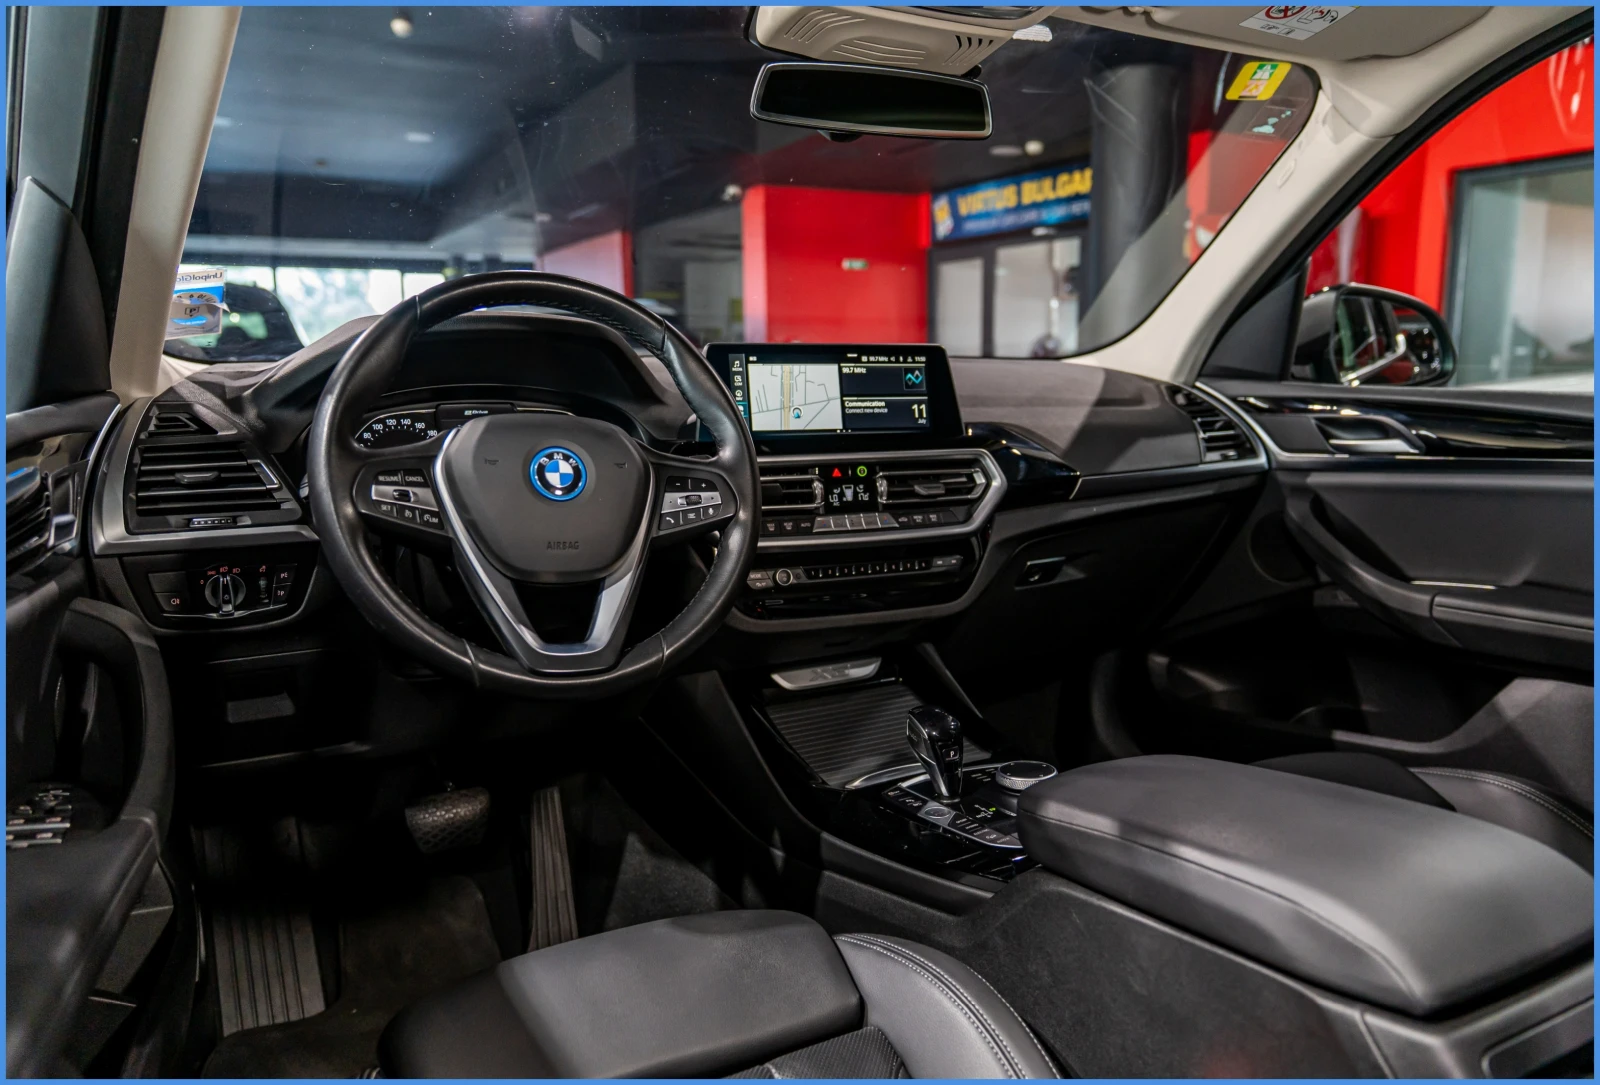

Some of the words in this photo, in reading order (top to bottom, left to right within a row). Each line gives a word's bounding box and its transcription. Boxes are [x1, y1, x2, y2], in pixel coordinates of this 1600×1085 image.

[957, 184, 1018, 216] VIRTUS
[912, 403, 927, 418] 11
[540, 452, 577, 467] BMW
[405, 475, 425, 483] CANCEL
[546, 541, 580, 551] AIRBAG
